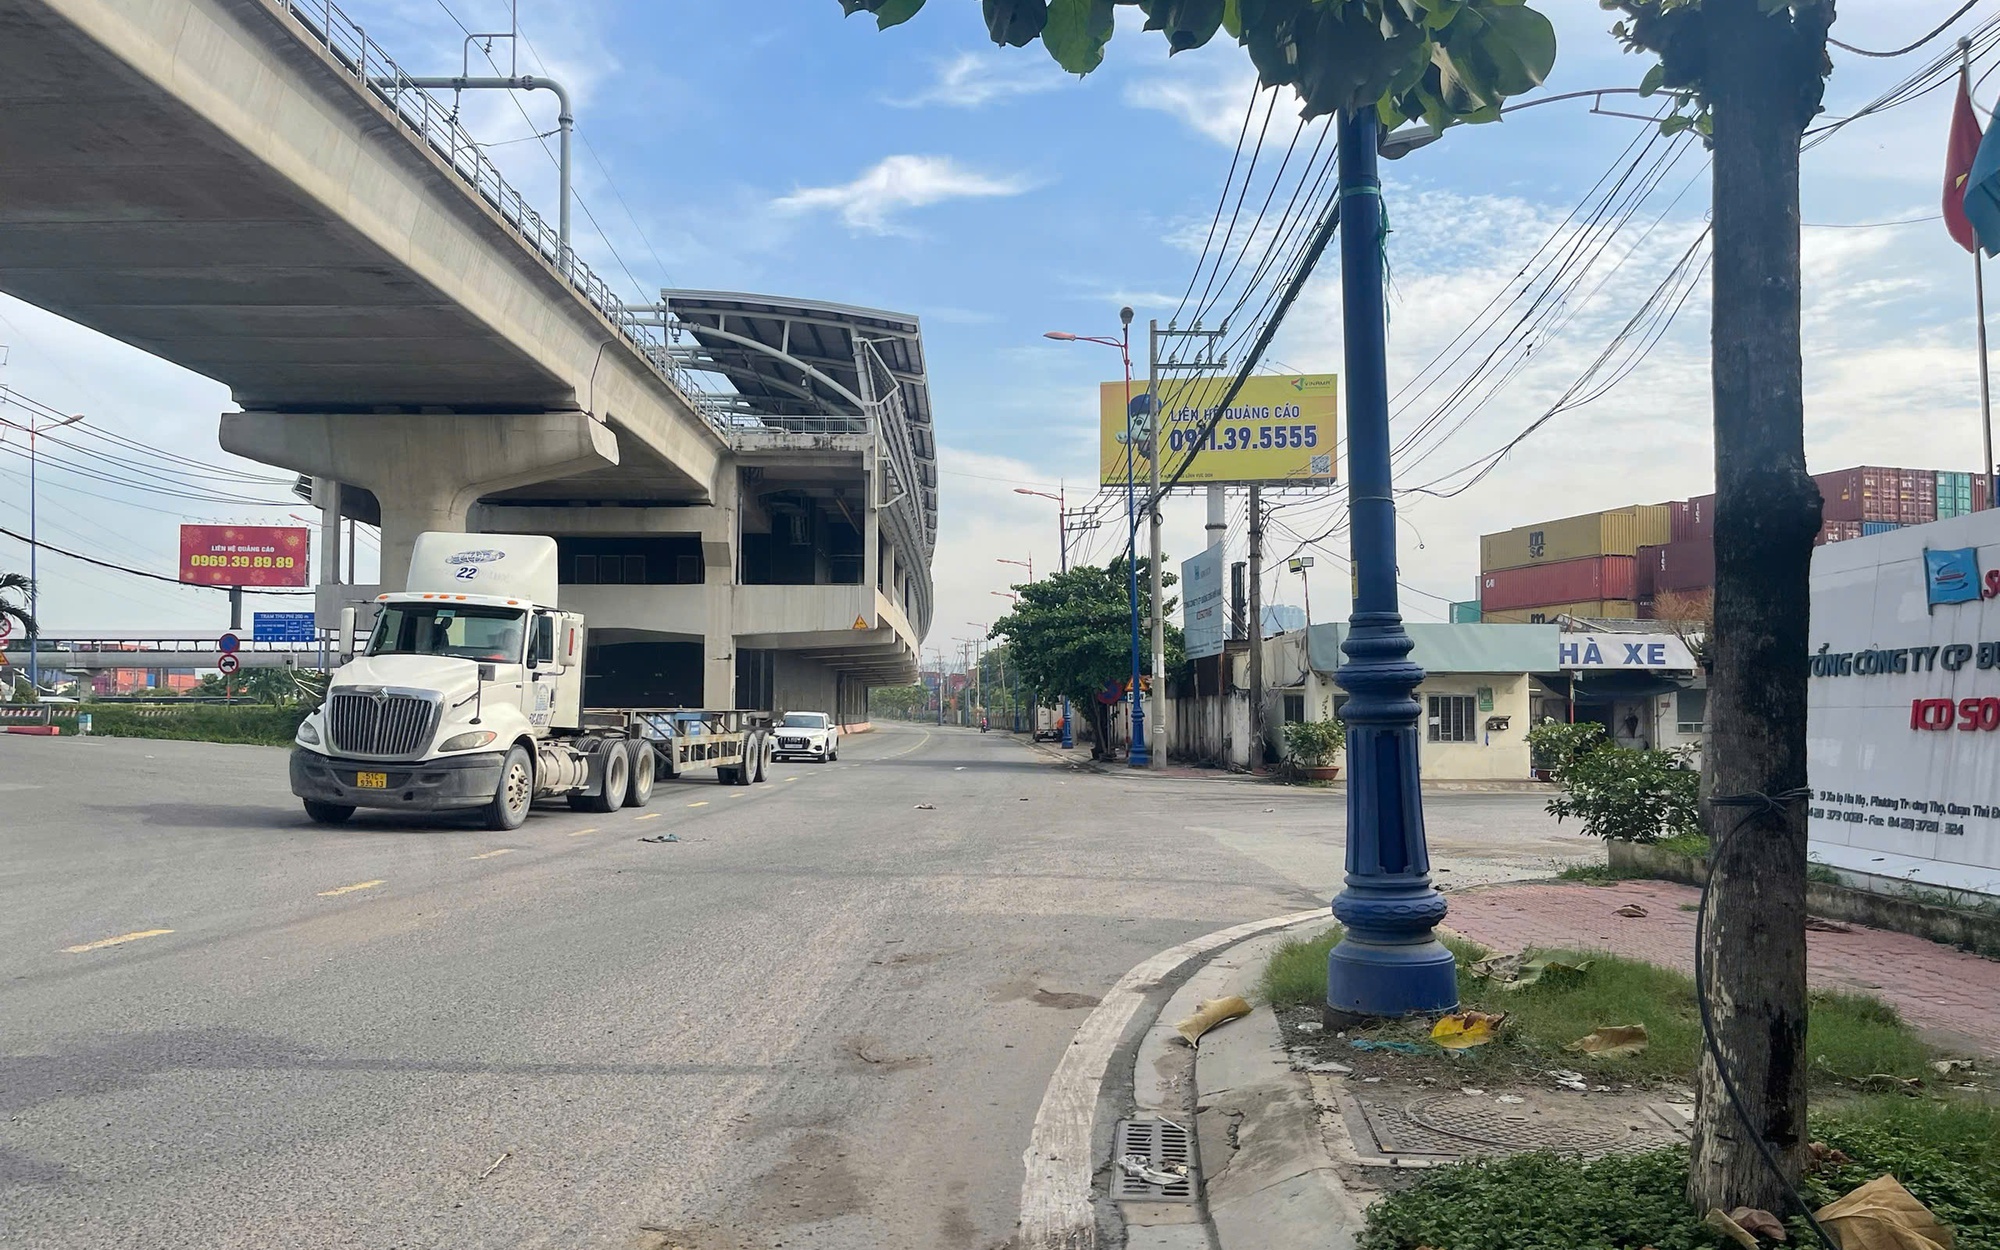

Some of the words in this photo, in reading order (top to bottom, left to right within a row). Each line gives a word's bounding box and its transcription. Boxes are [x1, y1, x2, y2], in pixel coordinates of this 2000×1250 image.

[1225, 404, 1269, 420] QUẢNG
[1274, 403, 1300, 419] CÁO
[211, 544, 226, 552] LIÊN
[190, 555, 294, 568] 0969.39.89.89
[456, 567, 477, 579] 22
[1622, 643, 1666, 665] XE
[1909, 645, 1940, 673] TY
[1940, 643, 1973, 672] CP
[1910, 698, 1955, 731] ICD
